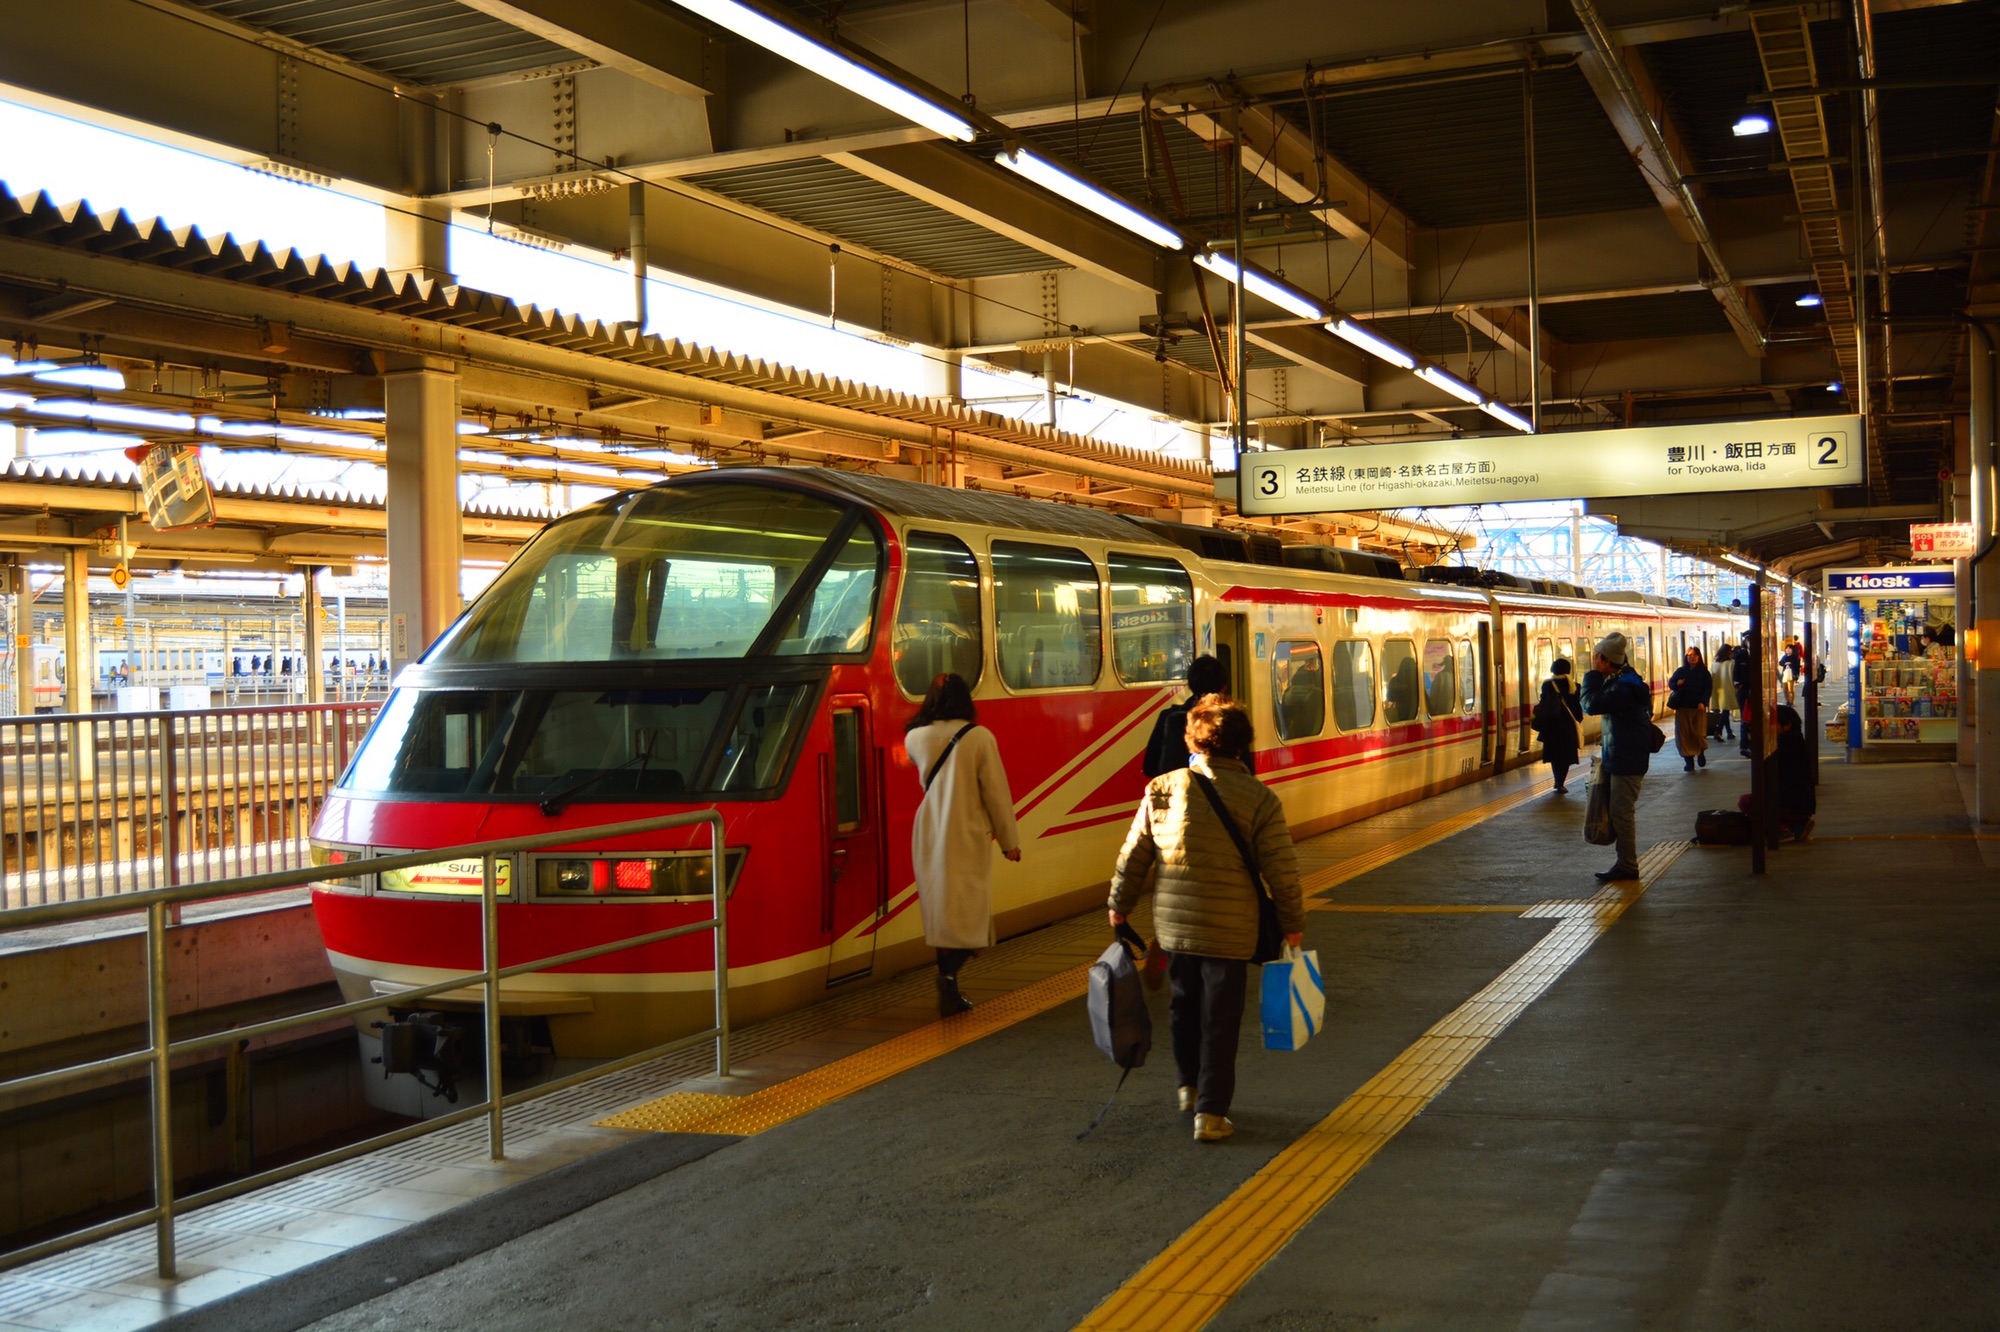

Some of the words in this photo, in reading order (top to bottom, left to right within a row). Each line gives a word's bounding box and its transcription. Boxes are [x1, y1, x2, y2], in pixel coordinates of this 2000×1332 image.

[1817, 437, 1838, 465] 2
[1667, 467, 1682, 475] for
[1686, 464, 1743, 476] Toyokawa,
[1746, 461, 1766, 471] Iida
[1261, 469, 1279, 495] 3
[1296, 484, 1334, 495] Meitetsu
[1337, 483, 1357, 493] Line
[1359, 481, 1376, 493] (for
[1846, 574, 1911, 588] Kiosk
[448, 863, 509, 875] supr
